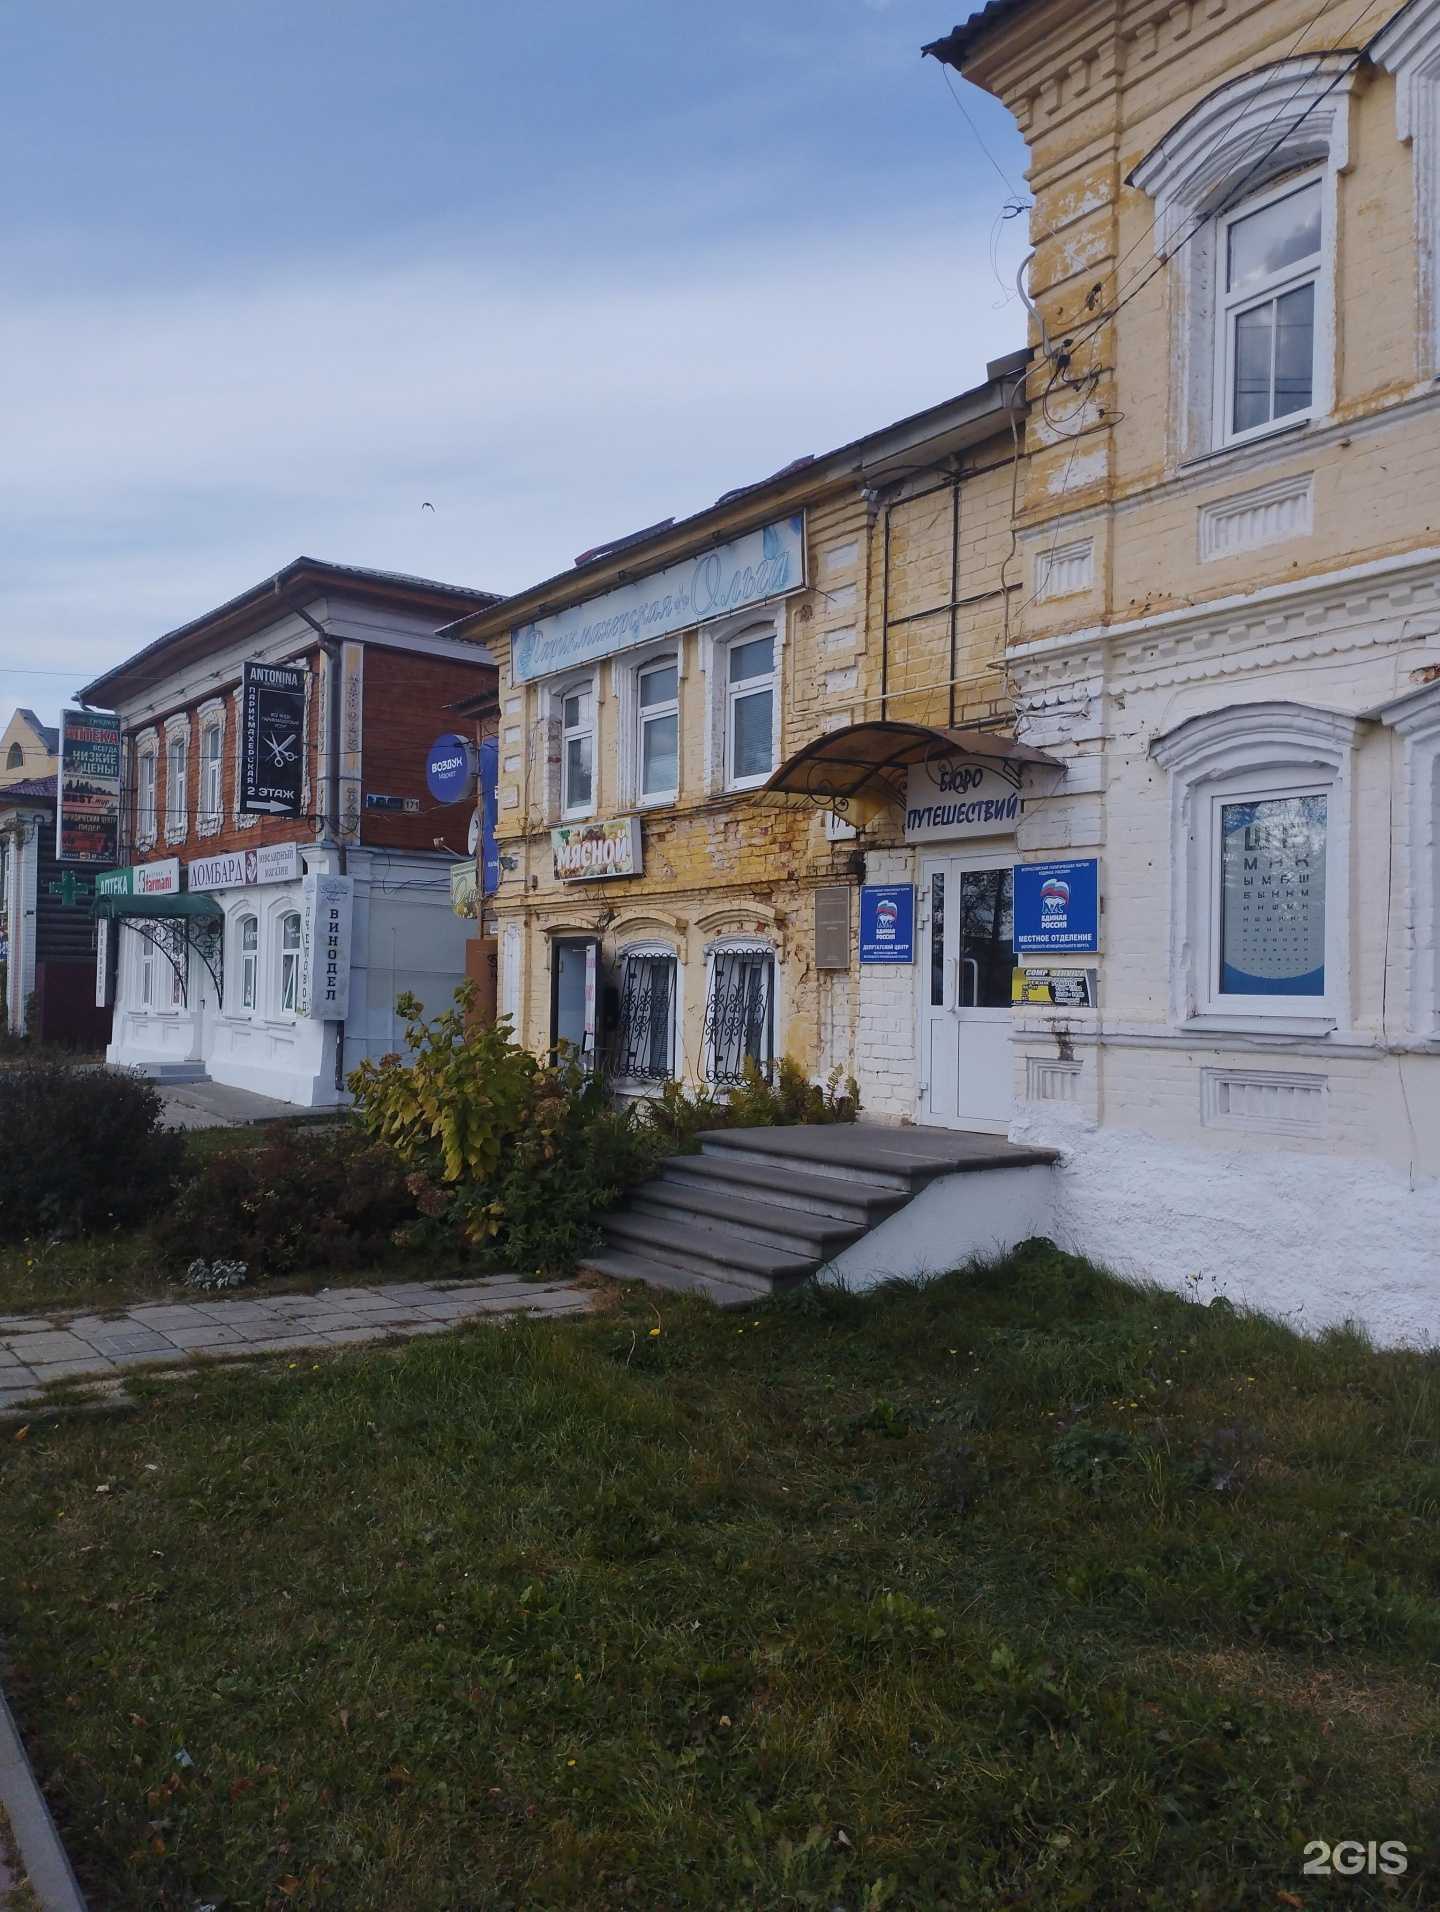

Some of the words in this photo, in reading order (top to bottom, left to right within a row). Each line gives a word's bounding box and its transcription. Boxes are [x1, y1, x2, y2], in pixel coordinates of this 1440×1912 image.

[250, 667, 298, 685] ANTONINA
[72, 751, 117, 765] НИЗКИЕ
[940, 767, 984, 792] БЮРО
[247, 786, 256, 796] 2
[258, 788, 295, 799] ЭТАЖ
[907, 792, 1019, 831] ПУТЕШЕСТВИЙ
[557, 828, 627, 870] МЯСНОЙ
[191, 858, 244, 887] ЛОМБАРД
[1244, 857, 1257, 870] М
[100, 875, 128, 894] АПТЕКА
[1041, 914, 1068, 922] ЕДИНАЯ
[1041, 921, 1068, 929] РОССИЯ
[1018, 934, 1050, 943] МЕСТНОЕ
[1051, 933, 1092, 942] ОТДЕЛЕНИЕ
[325, 908, 340, 1001] ВИНОДЕЛ
